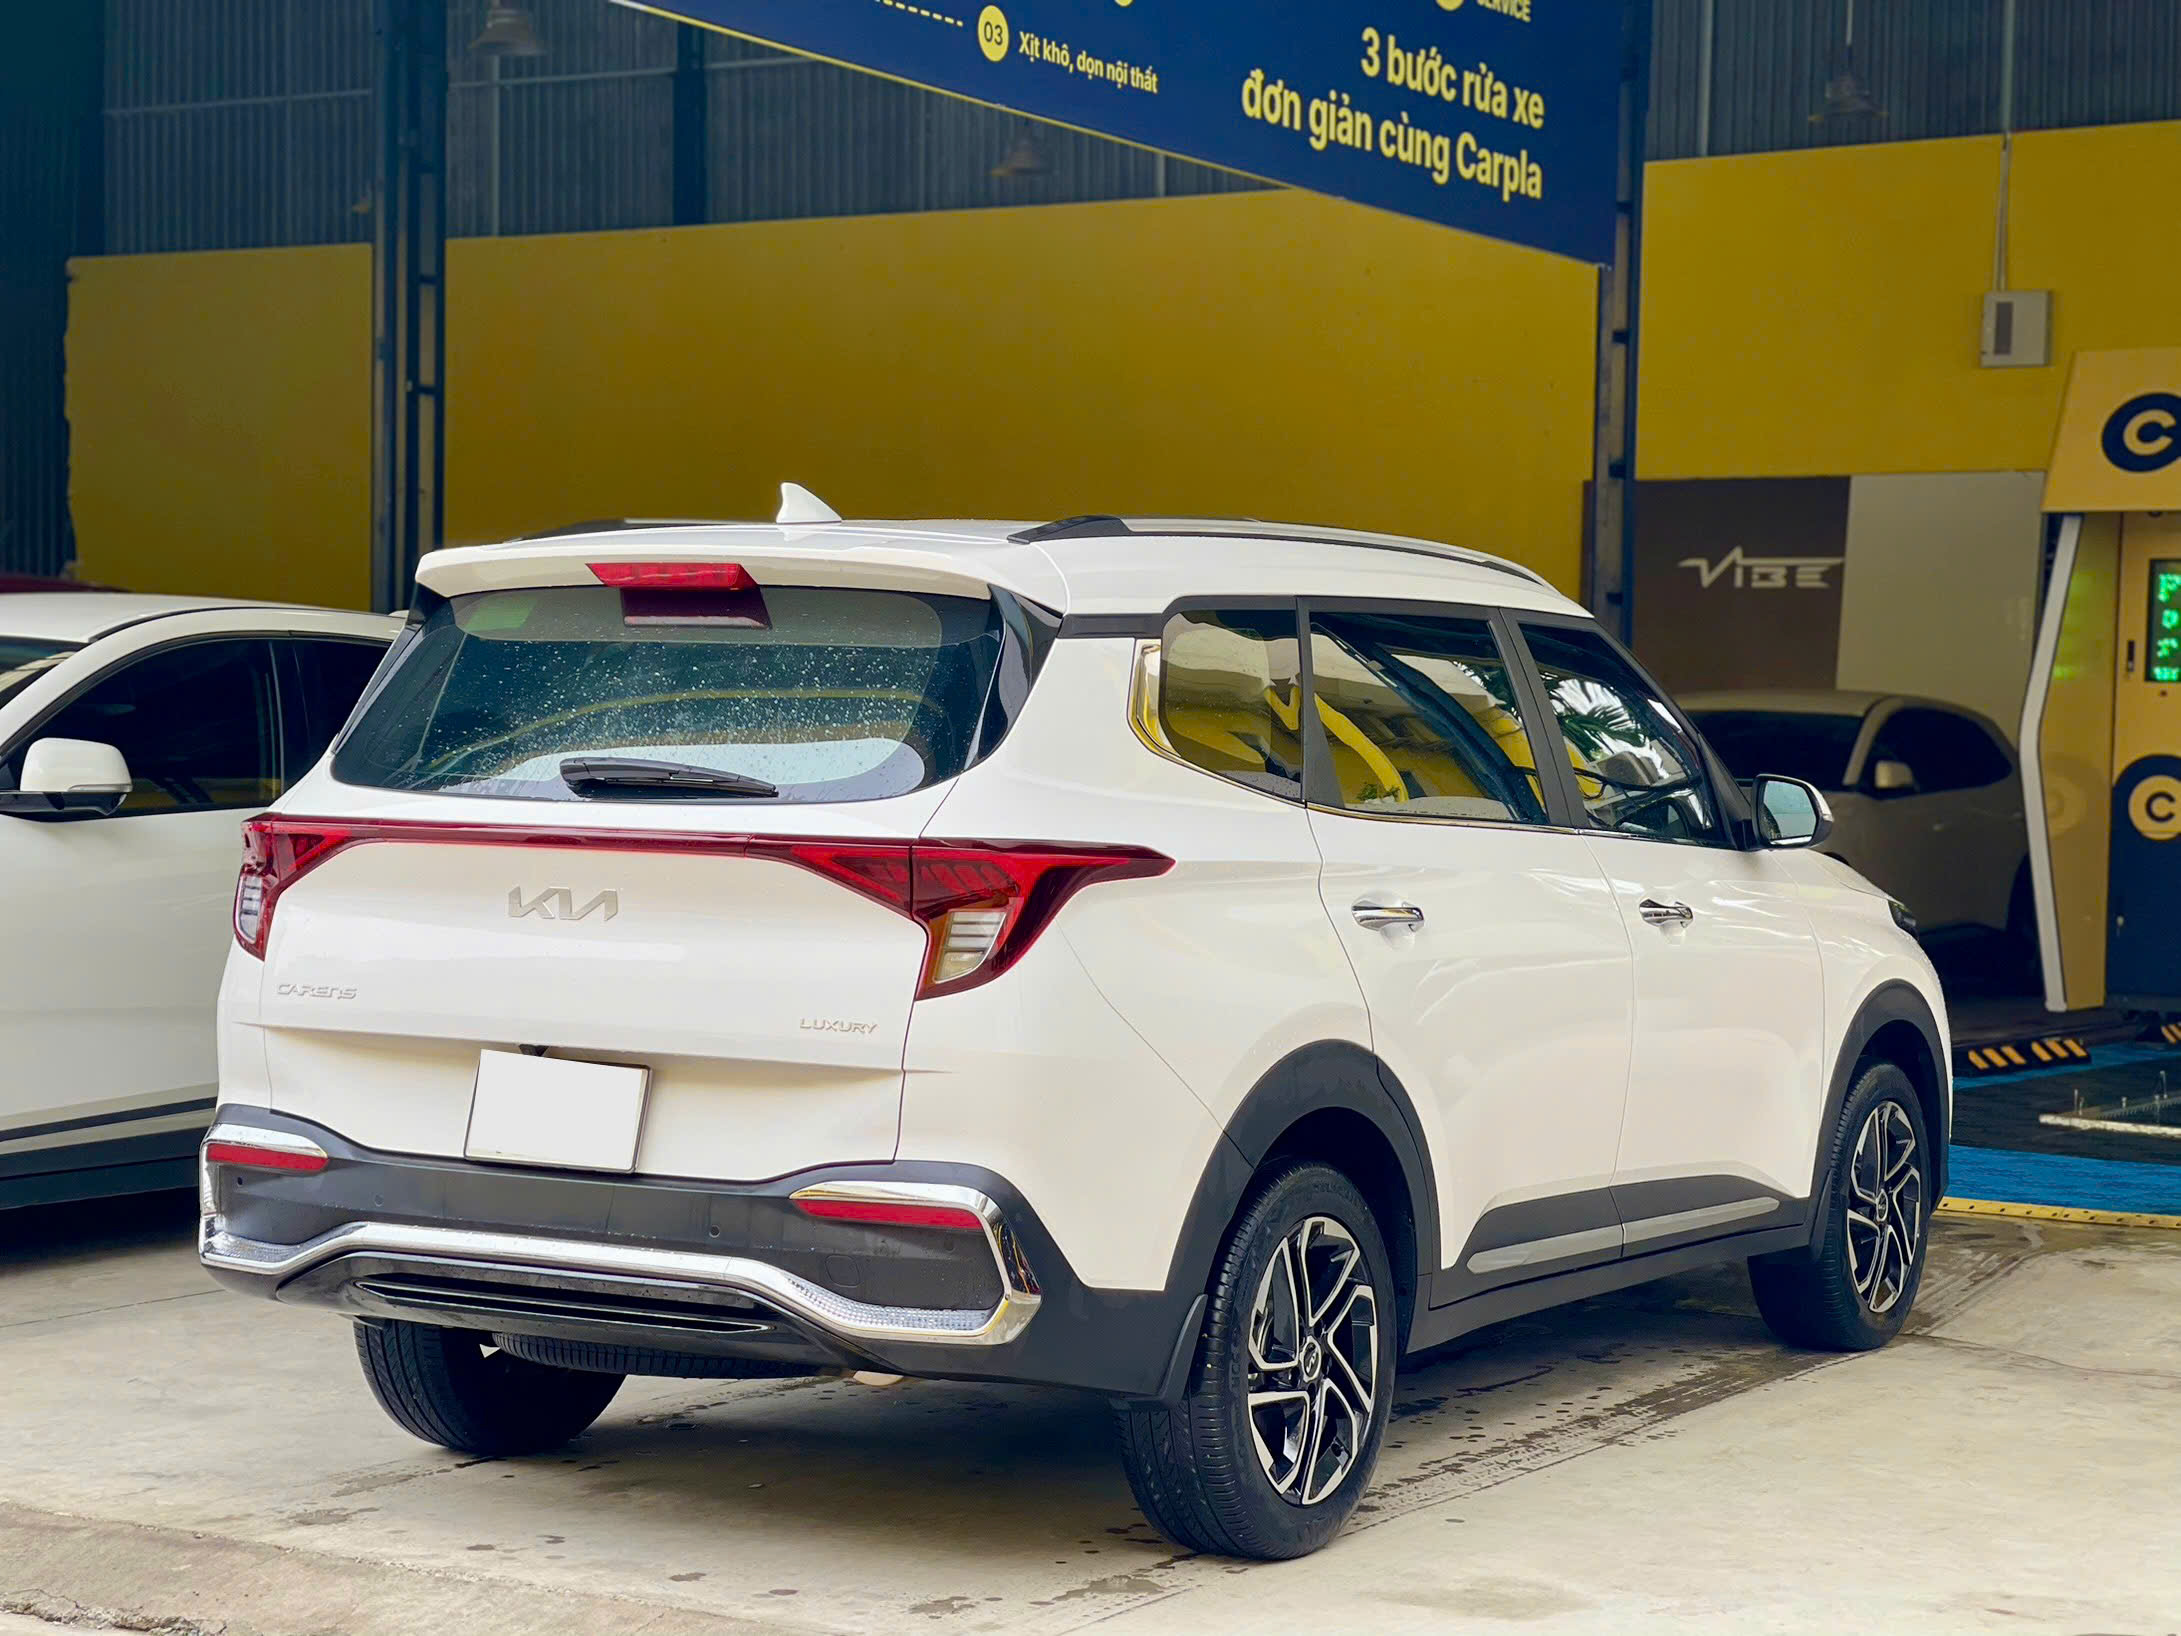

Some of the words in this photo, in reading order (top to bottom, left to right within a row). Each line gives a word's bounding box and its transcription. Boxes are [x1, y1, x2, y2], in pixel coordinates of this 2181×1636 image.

[1477, 0, 1531, 22] RVICE
[984, 21, 1003, 46] 03
[1019, 31, 1041, 63] Xịt
[1041, 38, 1074, 73] khô,
[1076, 51, 1104, 80] dọn
[1106, 60, 1129, 89] nội
[1130, 65, 1159, 94] thất
[1360, 27, 1382, 77] 3
[1387, 35, 1458, 102] bước
[1462, 63, 1509, 119] rửa
[1512, 87, 1546, 129] xe
[1241, 68, 1302, 131] đơn
[1309, 90, 1374, 152] giản
[1378, 112, 1451, 186] cùng
[1456, 132, 1543, 203] Carpla
[1678, 545, 1845, 589] VIBE
[508, 886, 618, 921] KIA
[277, 984, 358, 1000] CARENS
[800, 1018, 878, 1034] LUXURY
